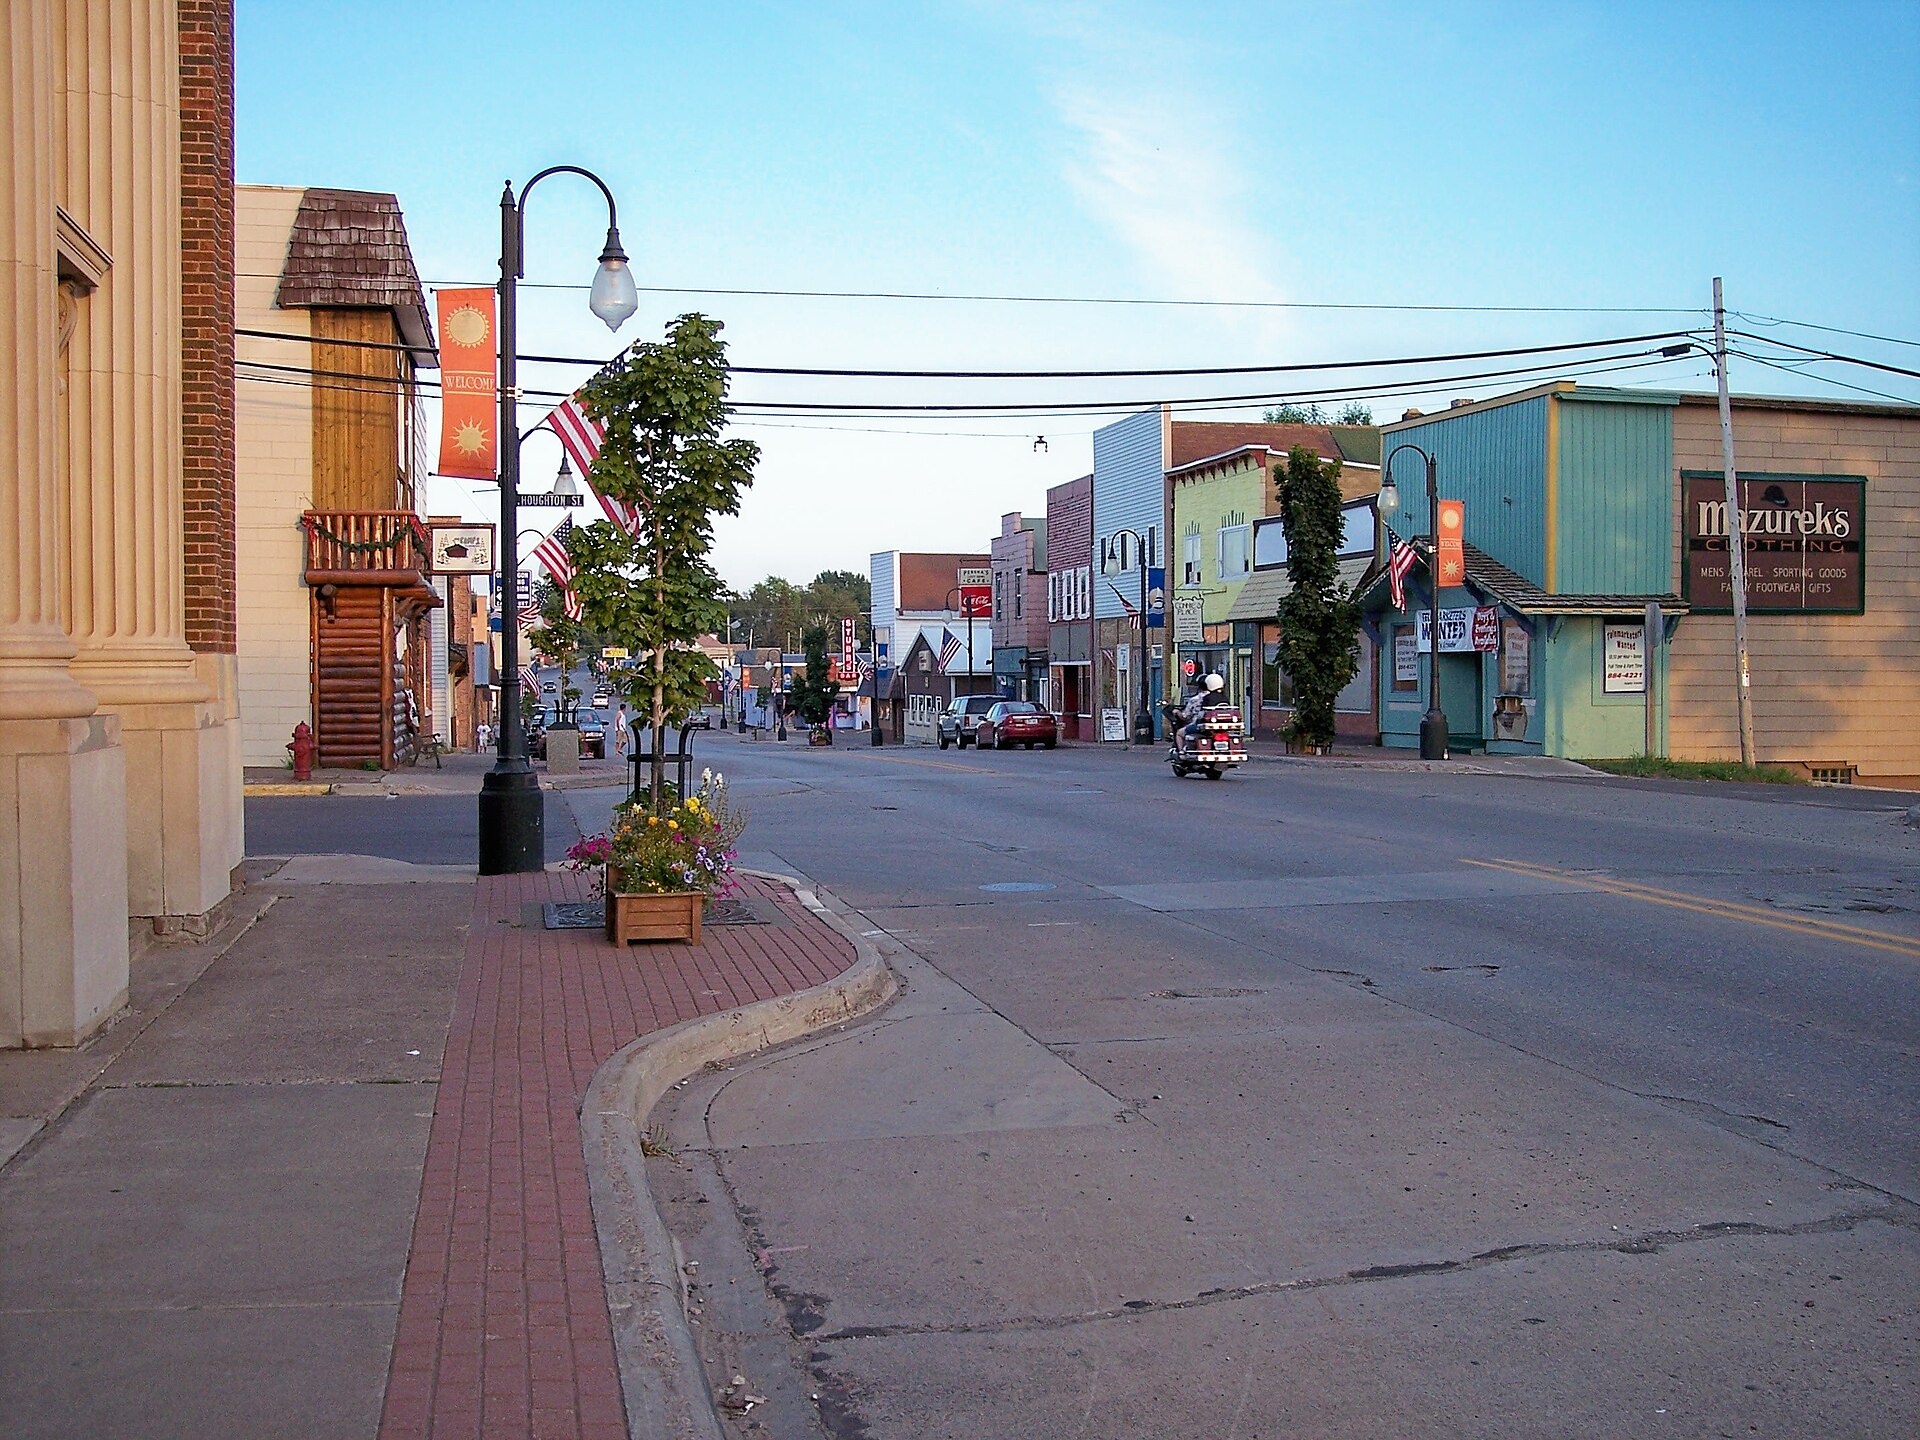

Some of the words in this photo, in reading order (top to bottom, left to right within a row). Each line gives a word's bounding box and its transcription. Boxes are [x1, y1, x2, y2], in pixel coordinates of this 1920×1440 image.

[445, 375, 496, 390] WELCOME
[521, 495, 566, 506] HOUGHTON
[571, 495, 582, 506] ST.
[1698, 500, 1850, 538] Mazurek's
[1700, 567, 1725, 578] MENS
[1819, 568, 1847, 578] GOODS
[1756, 582, 1801, 593] FOOTWEAR
[1808, 583, 1832, 593] GIFTS
[1422, 621, 1467, 640] WNTED
